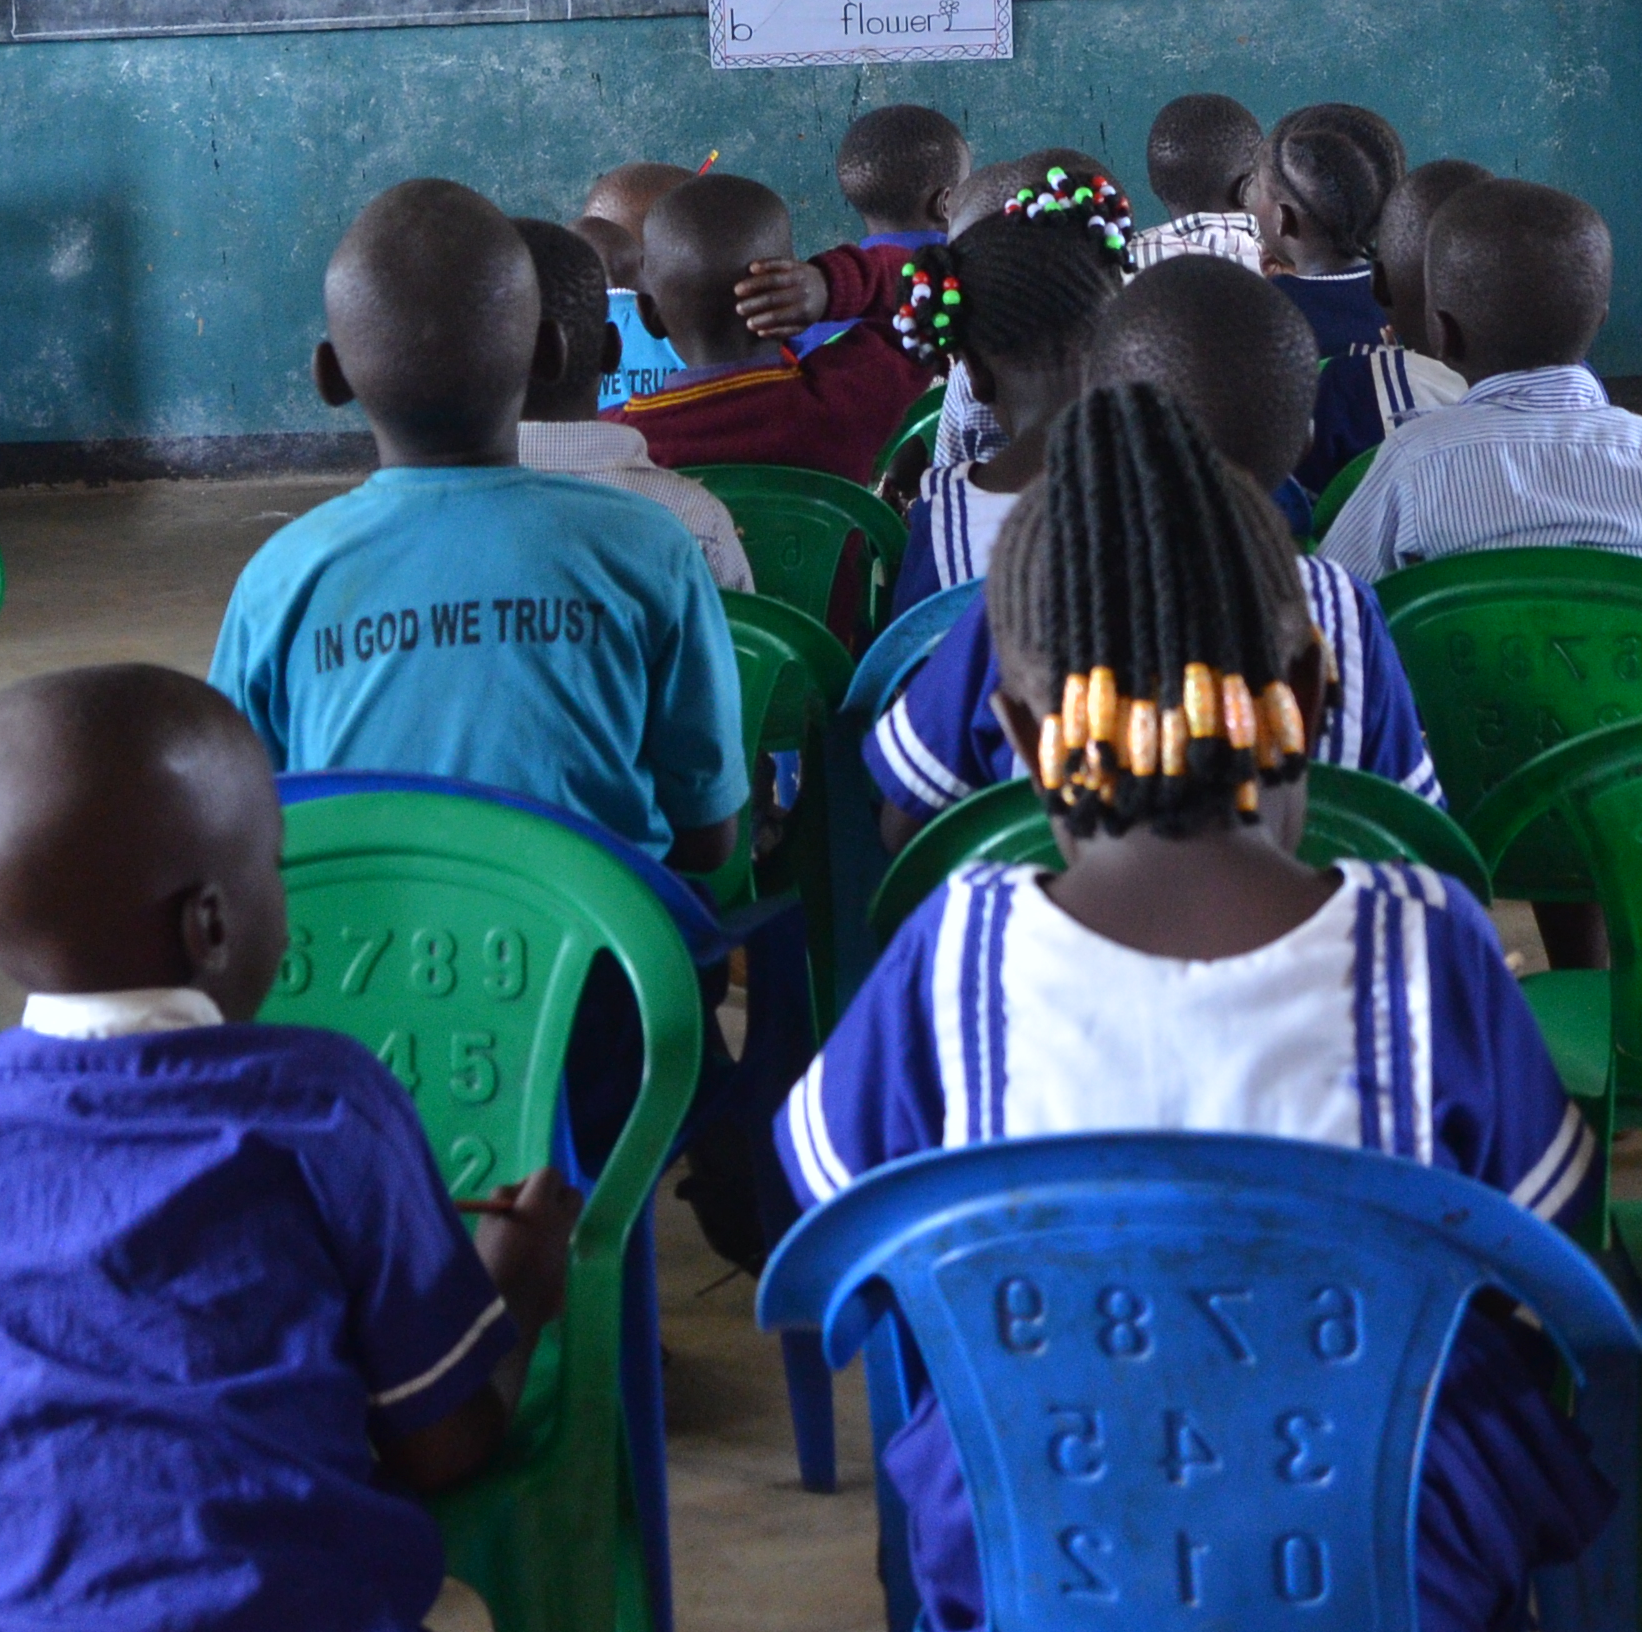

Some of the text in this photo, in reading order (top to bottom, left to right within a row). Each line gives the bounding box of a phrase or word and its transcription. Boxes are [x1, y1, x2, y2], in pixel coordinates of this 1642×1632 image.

[730, 7, 754, 42] b
[841, 1, 941, 36] flower
[314, 596, 607, 674] IN GOD WE TRUST
